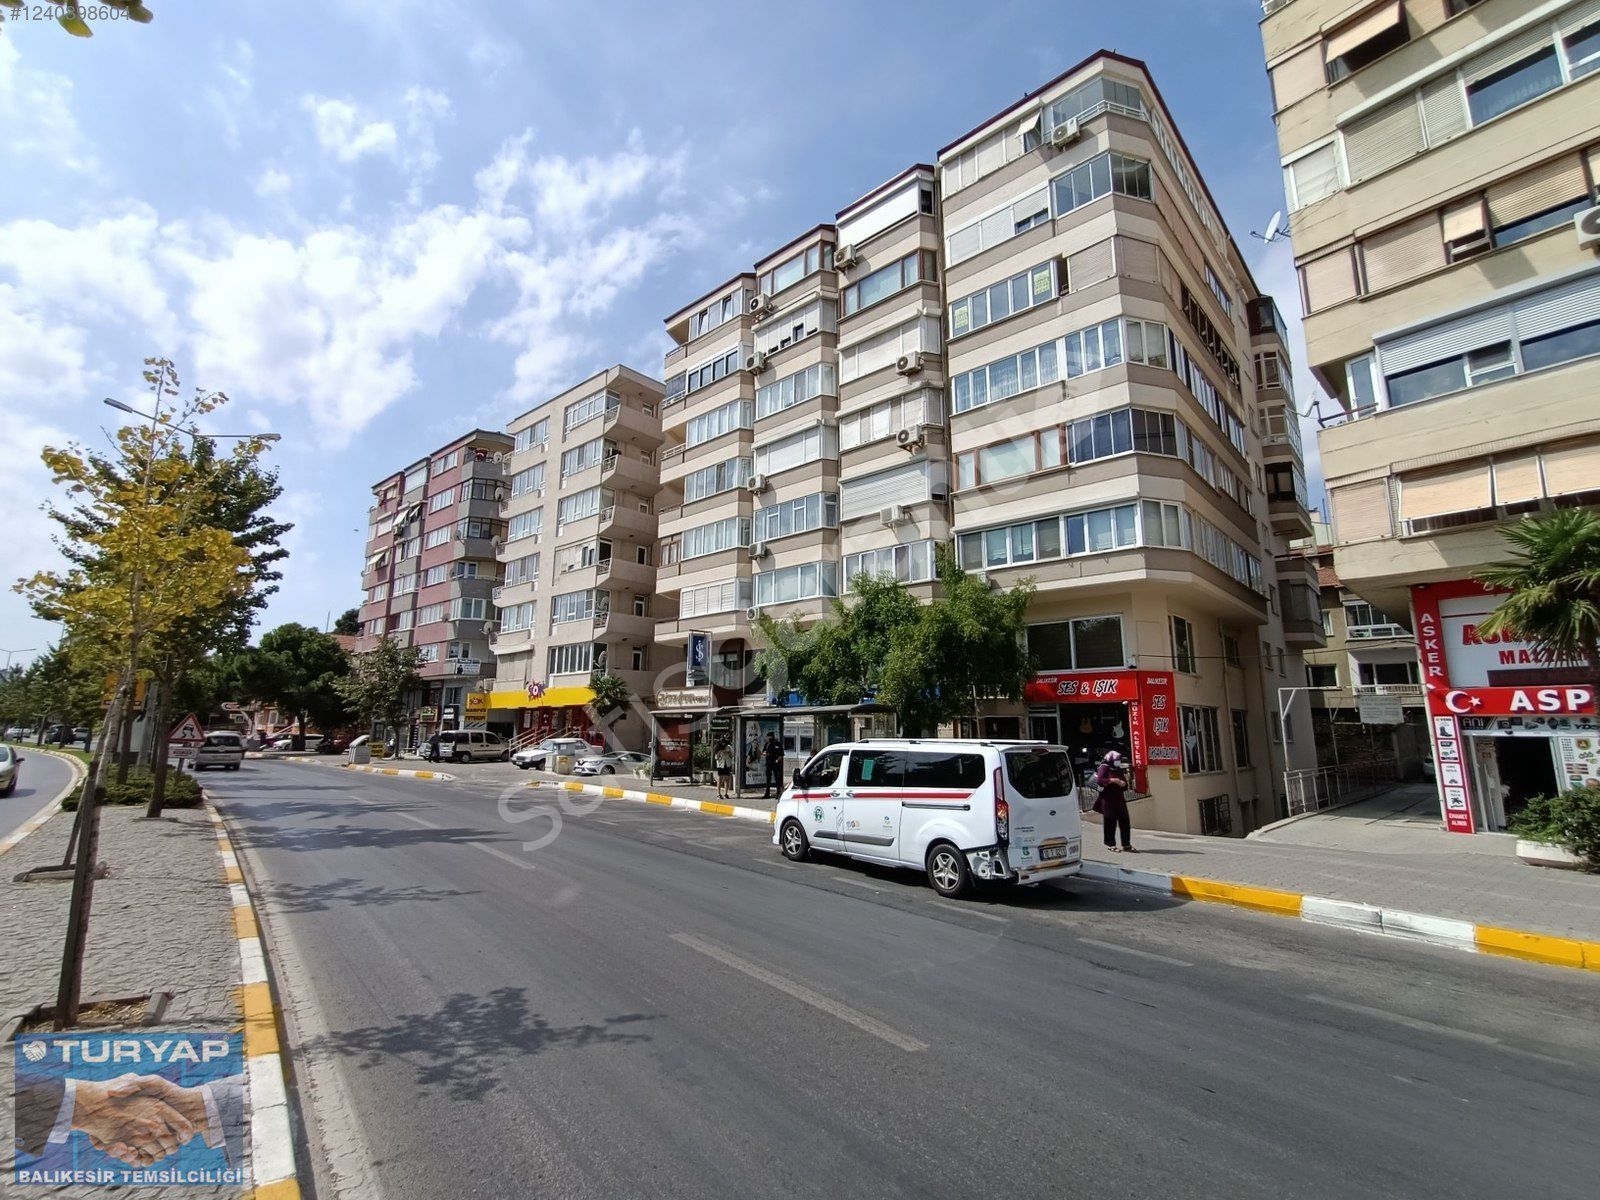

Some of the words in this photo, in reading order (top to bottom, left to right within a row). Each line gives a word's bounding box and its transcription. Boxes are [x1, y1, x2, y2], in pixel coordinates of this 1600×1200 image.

[1420, 613, 1444, 677] ASKER
[1056, 680, 1079, 695] SES
[1079, 681, 1090, 695] &
[1092, 678, 1119, 697] IŞIK
[1152, 694, 1166, 710] SES
[1509, 689, 1591, 712] ASP
[1153, 717, 1169, 736] IŞIK
